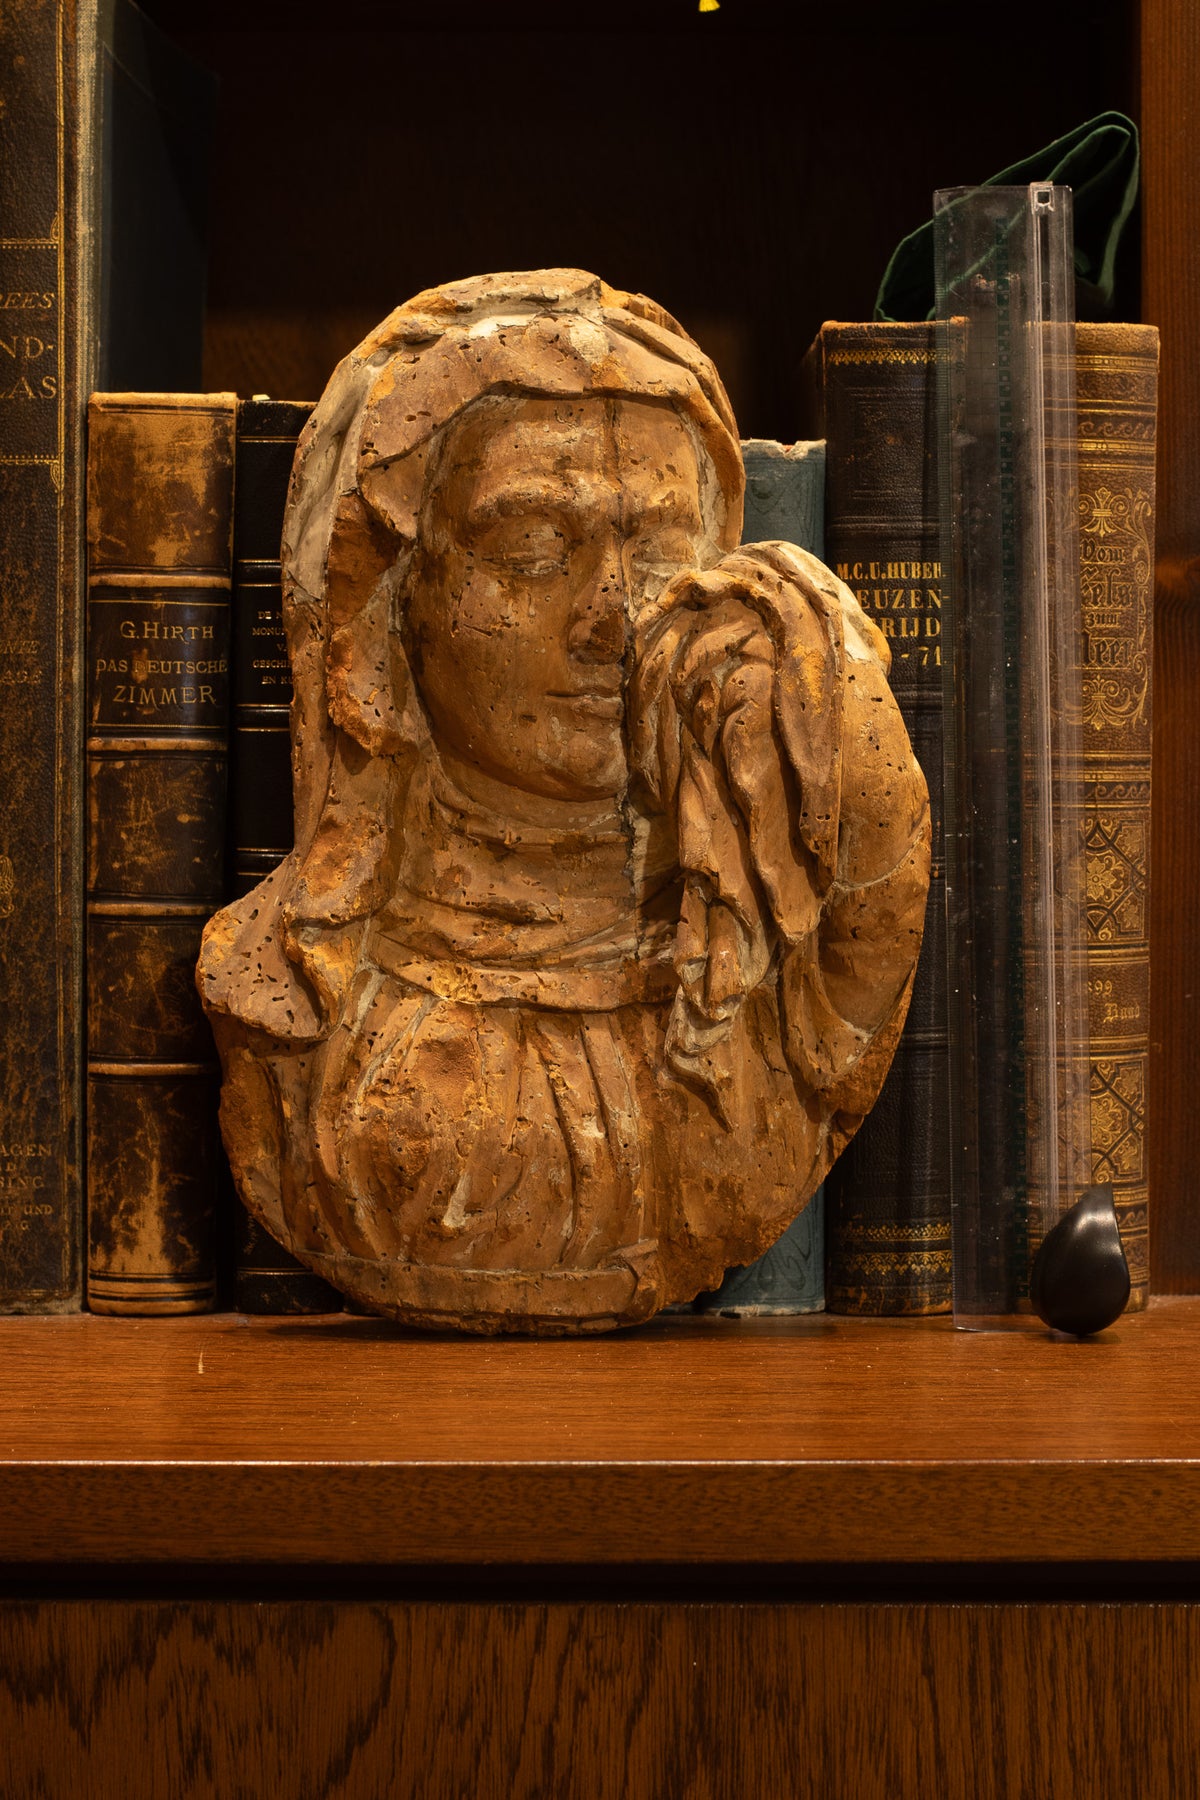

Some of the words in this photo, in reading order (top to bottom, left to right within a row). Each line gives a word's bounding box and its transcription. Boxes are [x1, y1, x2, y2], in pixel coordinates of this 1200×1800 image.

[0, 375, 57, 399] AS
[1080, 538, 1125, 561] Vom
[872, 616, 942, 638] RIJD
[1085, 611, 1120, 627] zum
[96, 658, 128, 673] DAS
[133, 659, 228, 674] DEUTSCHE
[113, 685, 216, 712] ZIMMER
